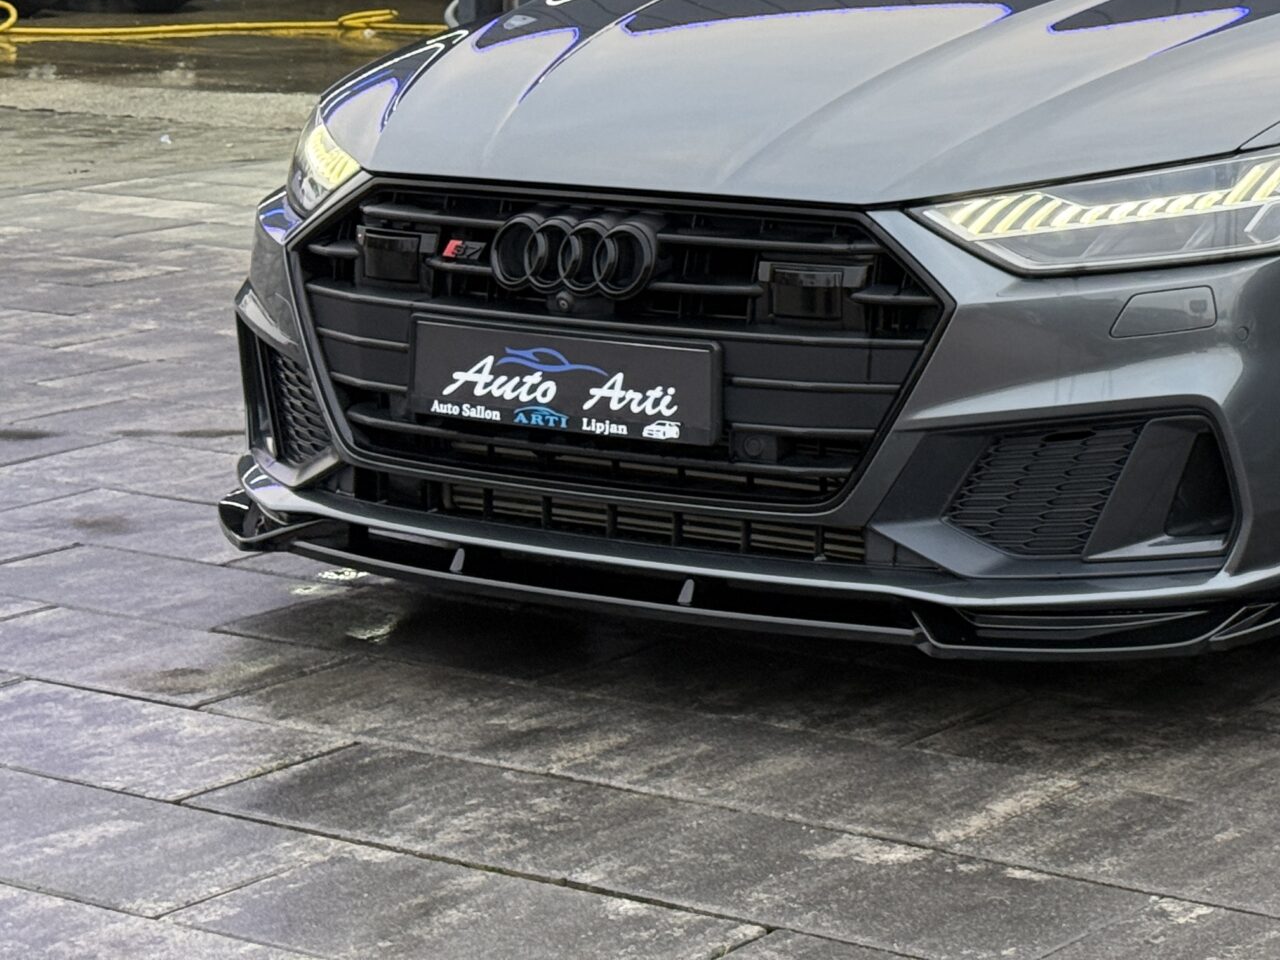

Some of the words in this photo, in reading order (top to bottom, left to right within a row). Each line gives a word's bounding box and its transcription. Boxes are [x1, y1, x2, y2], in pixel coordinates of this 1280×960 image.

[449, 240, 486, 259] S7
[442, 355, 557, 404] Auto
[582, 372, 679, 417] Arti
[430, 400, 460, 415] Auto
[461, 403, 501, 420] Sallon
[513, 412, 568, 428] ARTI
[582, 417, 628, 435] Lipjan
